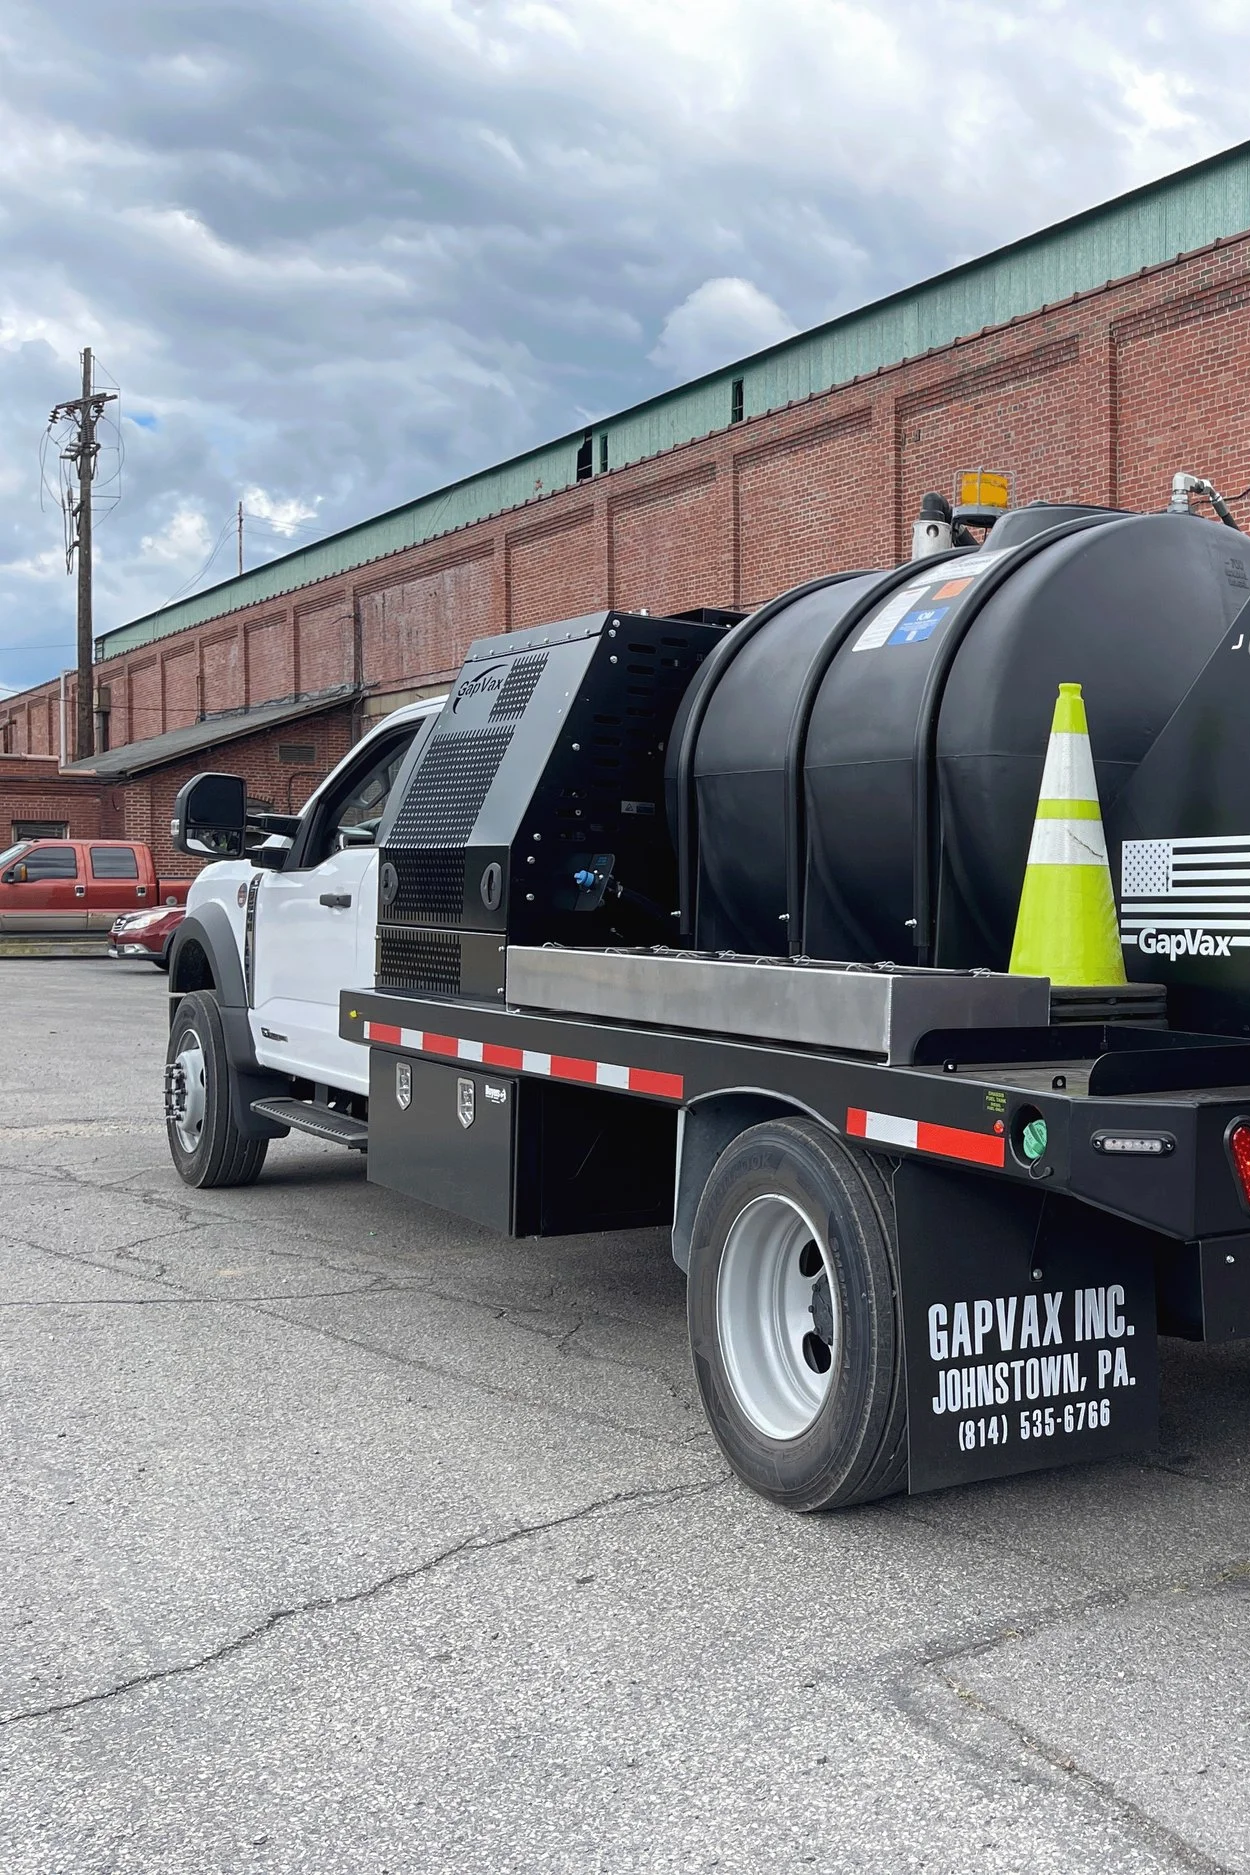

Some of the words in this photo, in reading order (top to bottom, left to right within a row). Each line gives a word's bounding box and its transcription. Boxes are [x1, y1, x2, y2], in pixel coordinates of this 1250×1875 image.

[457, 676, 504, 698] GapVax
[1138, 927, 1232, 962] GapVax
[928, 1291, 1064, 1361] GAPVAX
[1074, 1284, 1135, 1342] INC.
[932, 1352, 1087, 1415] JOHNSTOWN,
[1098, 1346, 1136, 1389] PA.
[958, 1414, 1008, 1452] (814)
[1019, 1398, 1111, 1440] 535-6766
